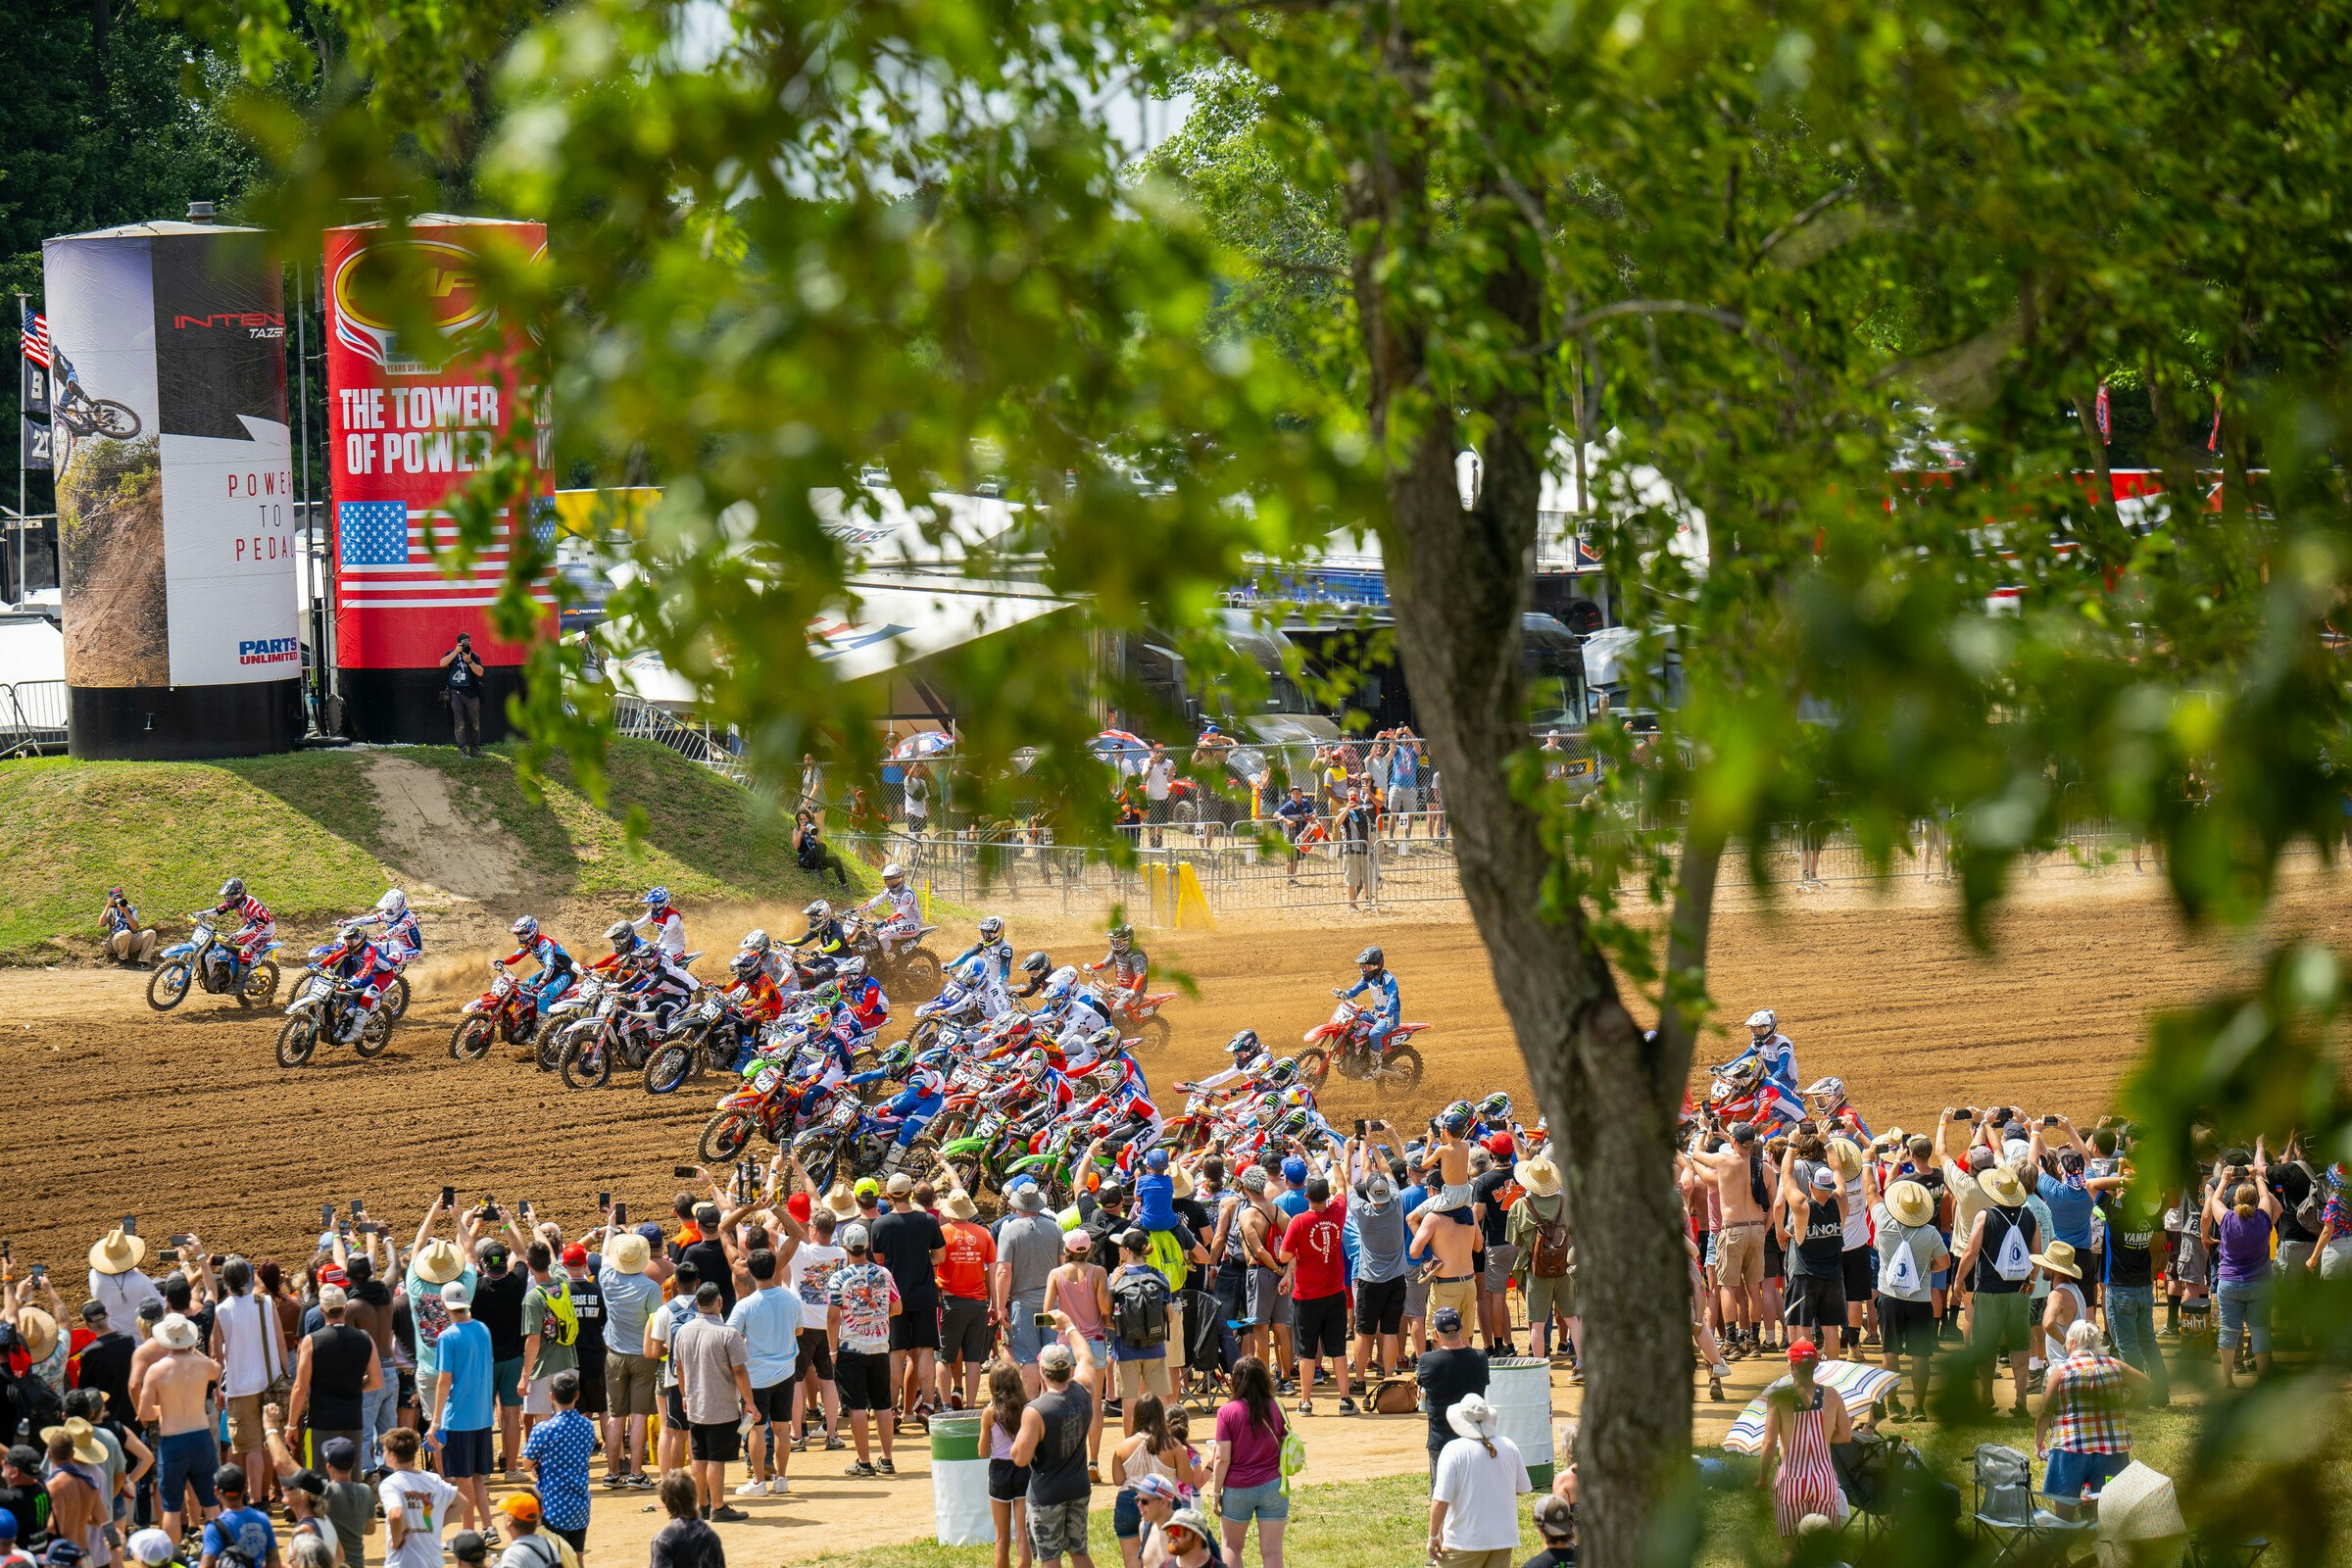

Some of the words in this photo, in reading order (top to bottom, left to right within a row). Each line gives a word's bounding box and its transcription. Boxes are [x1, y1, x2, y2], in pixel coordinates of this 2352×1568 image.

[174, 313, 284, 329] INTEN
[386, 364, 406, 372] YEARS
[407, 364, 416, 372] OF
[339, 388, 385, 430] THE
[392, 385, 499, 428] TOWER
[347, 433, 376, 475] OF
[383, 430, 492, 474] POWER
[259, 504, 282, 528] TO
[238, 637, 298, 657] PARTS
[239, 651, 298, 666] UNLIMITED
[1398, 817, 1408, 827] 27
[1044, 833, 1054, 842] 22
[1195, 828, 1204, 838] 24
[896, 923, 915, 932] FXR
[1390, 1033, 1408, 1047] 162
